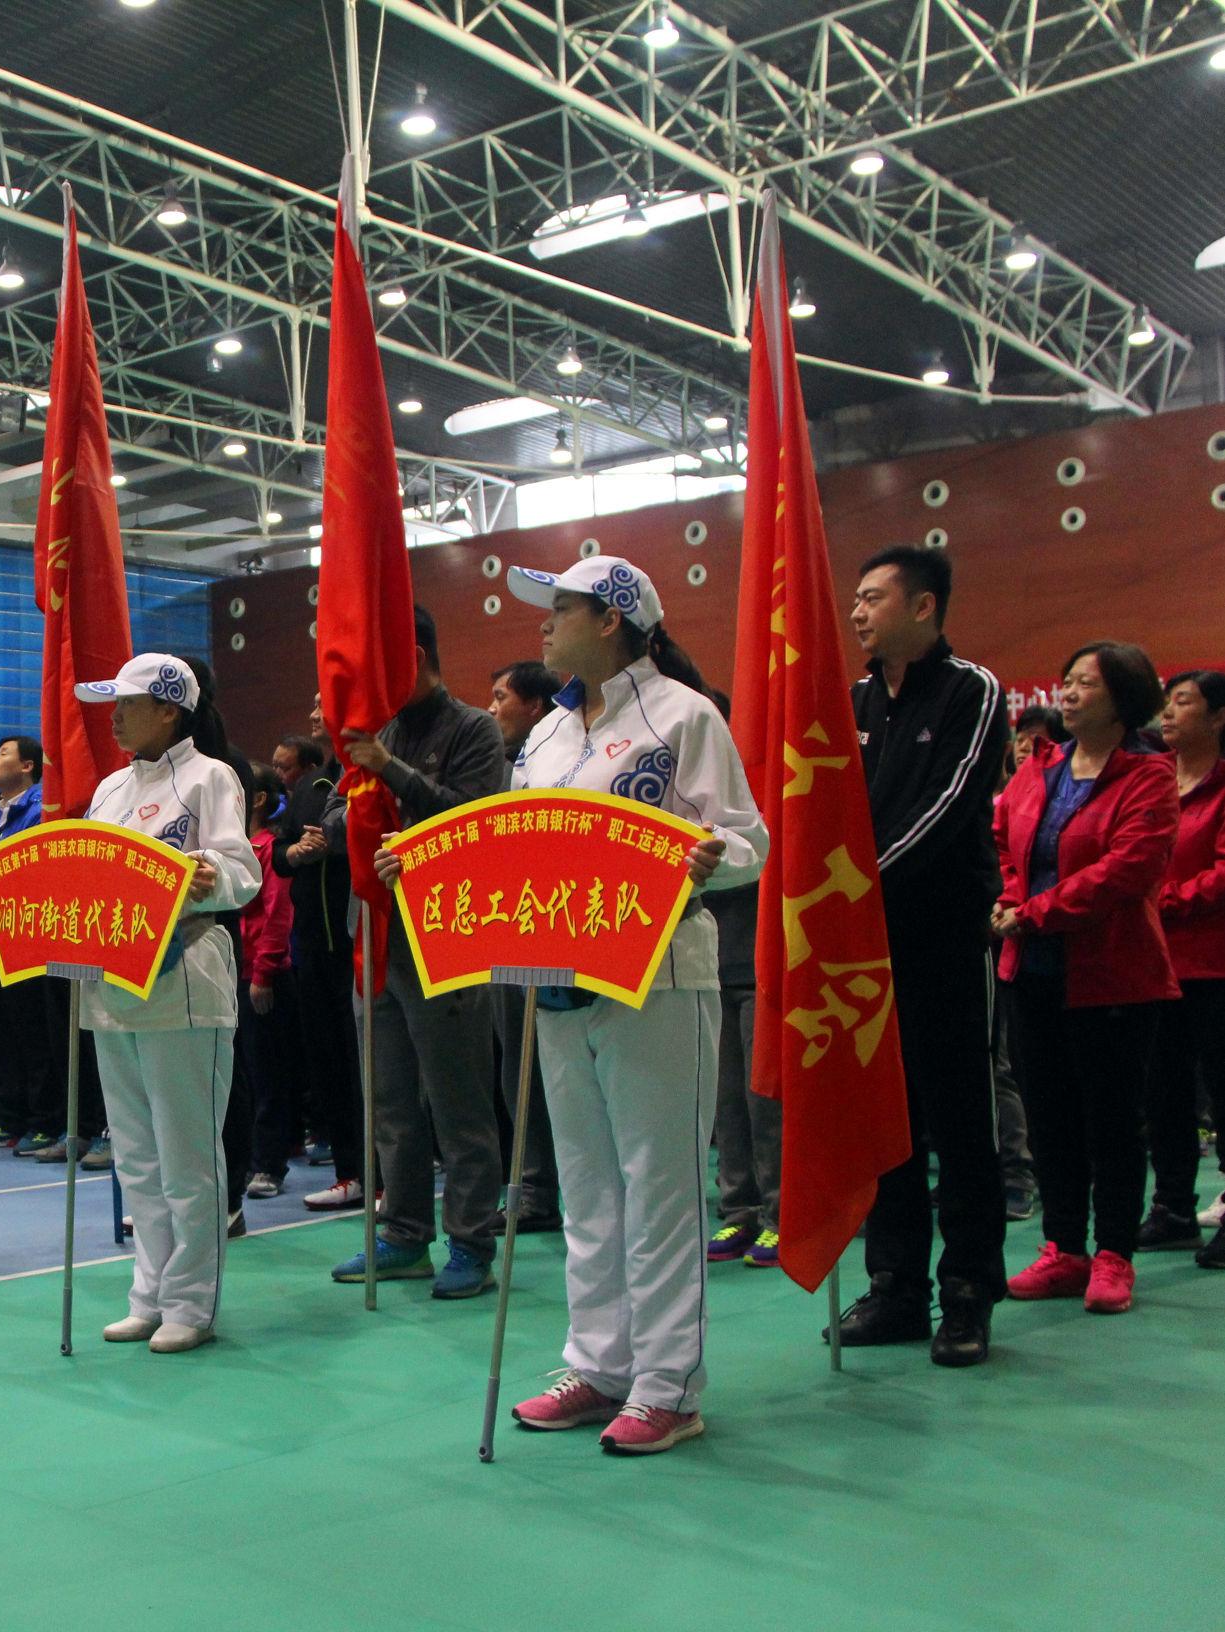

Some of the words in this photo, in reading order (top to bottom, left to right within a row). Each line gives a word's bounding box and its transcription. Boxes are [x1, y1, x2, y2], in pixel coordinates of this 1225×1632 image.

[423, 876, 653, 938] 区总工会代表队
